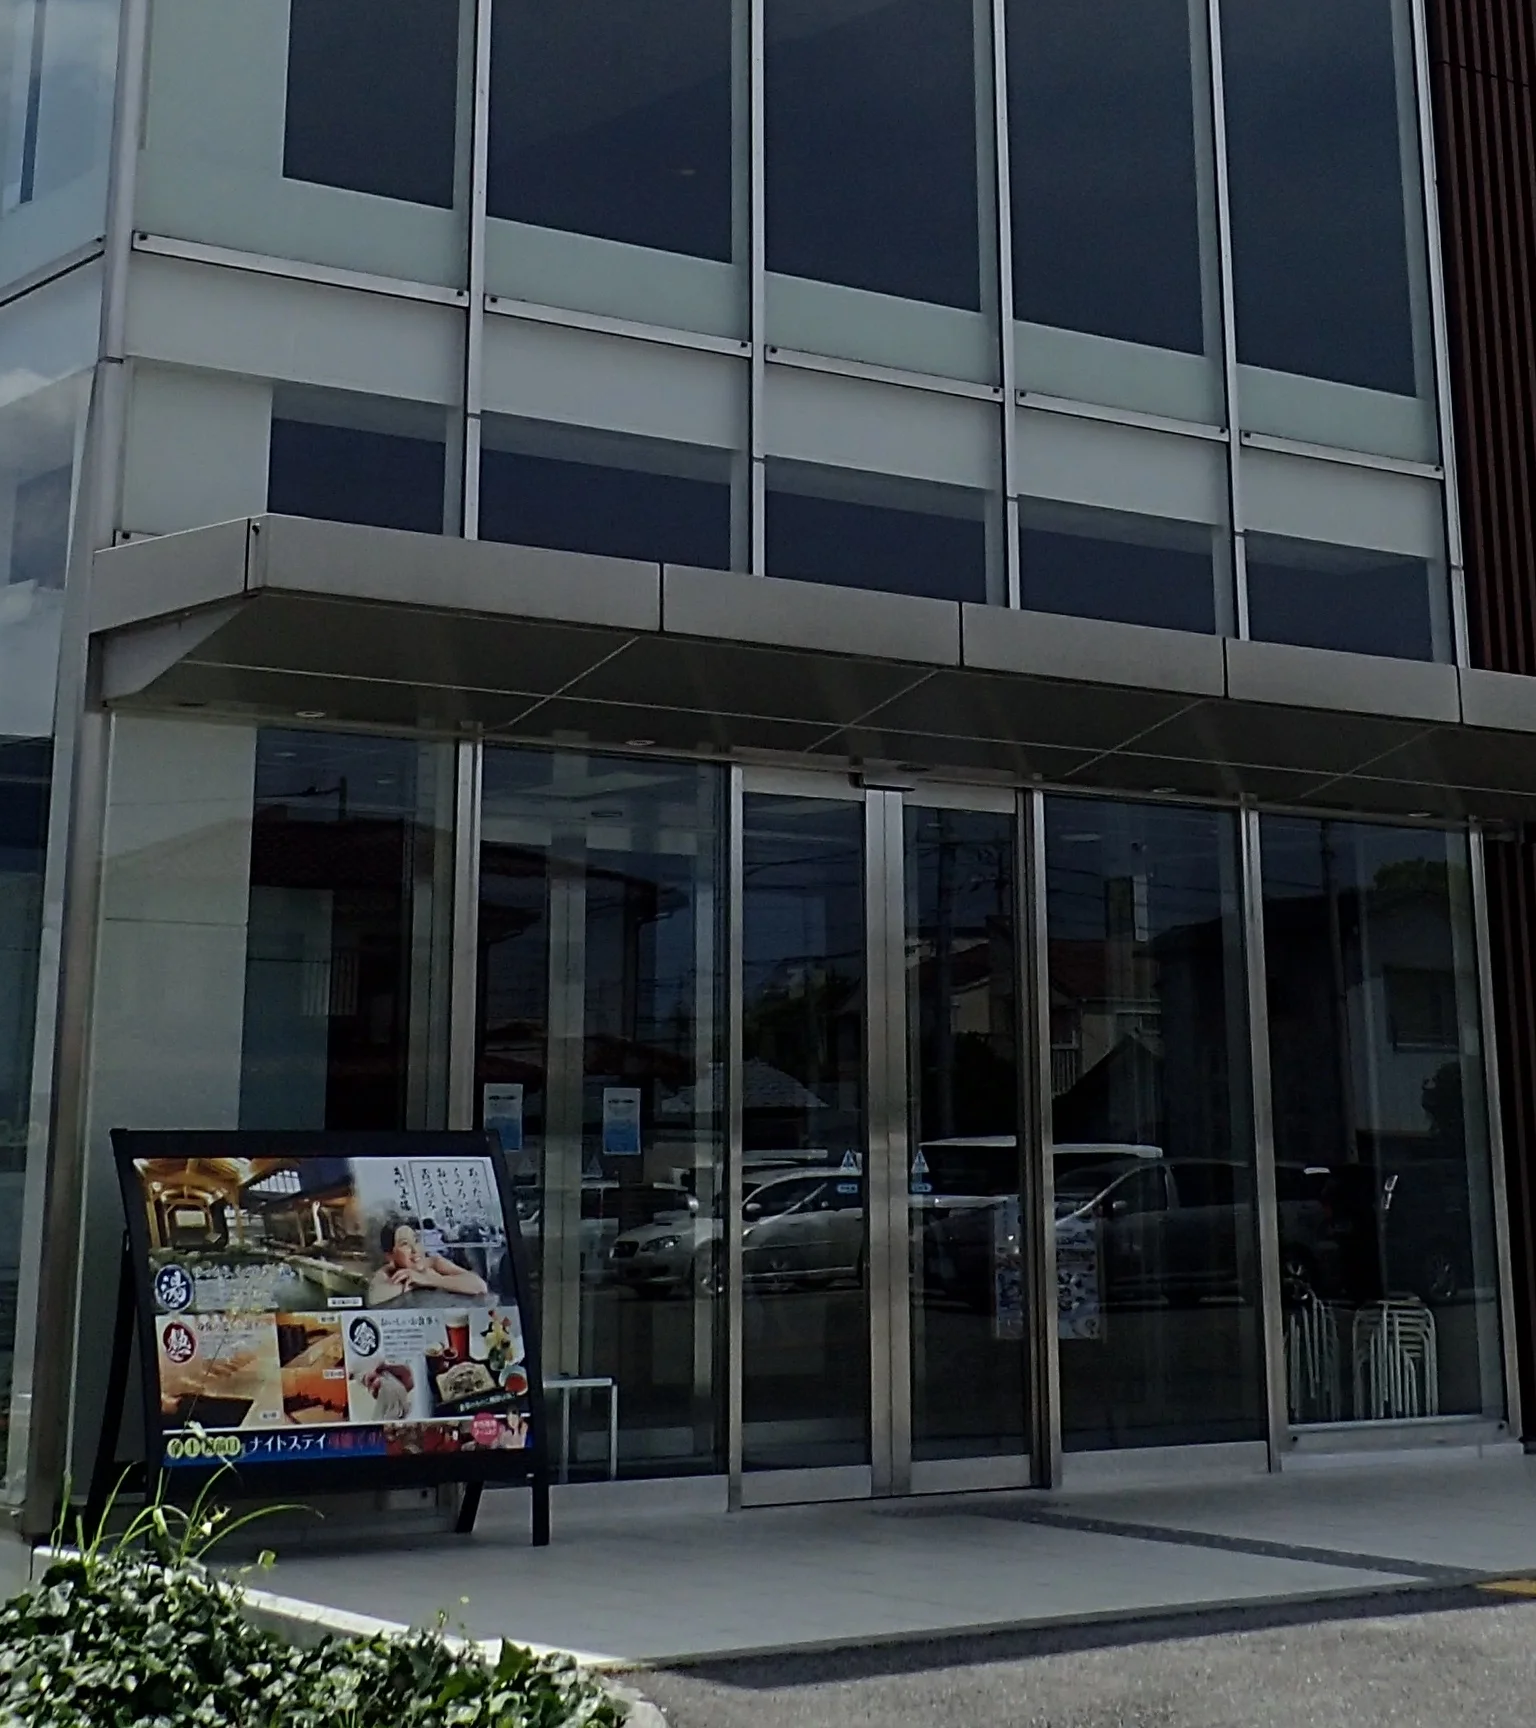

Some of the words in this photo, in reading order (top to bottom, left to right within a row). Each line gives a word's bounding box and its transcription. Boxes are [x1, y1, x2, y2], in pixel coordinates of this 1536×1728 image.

[249, 1433, 327, 1453] ナイトステイ
